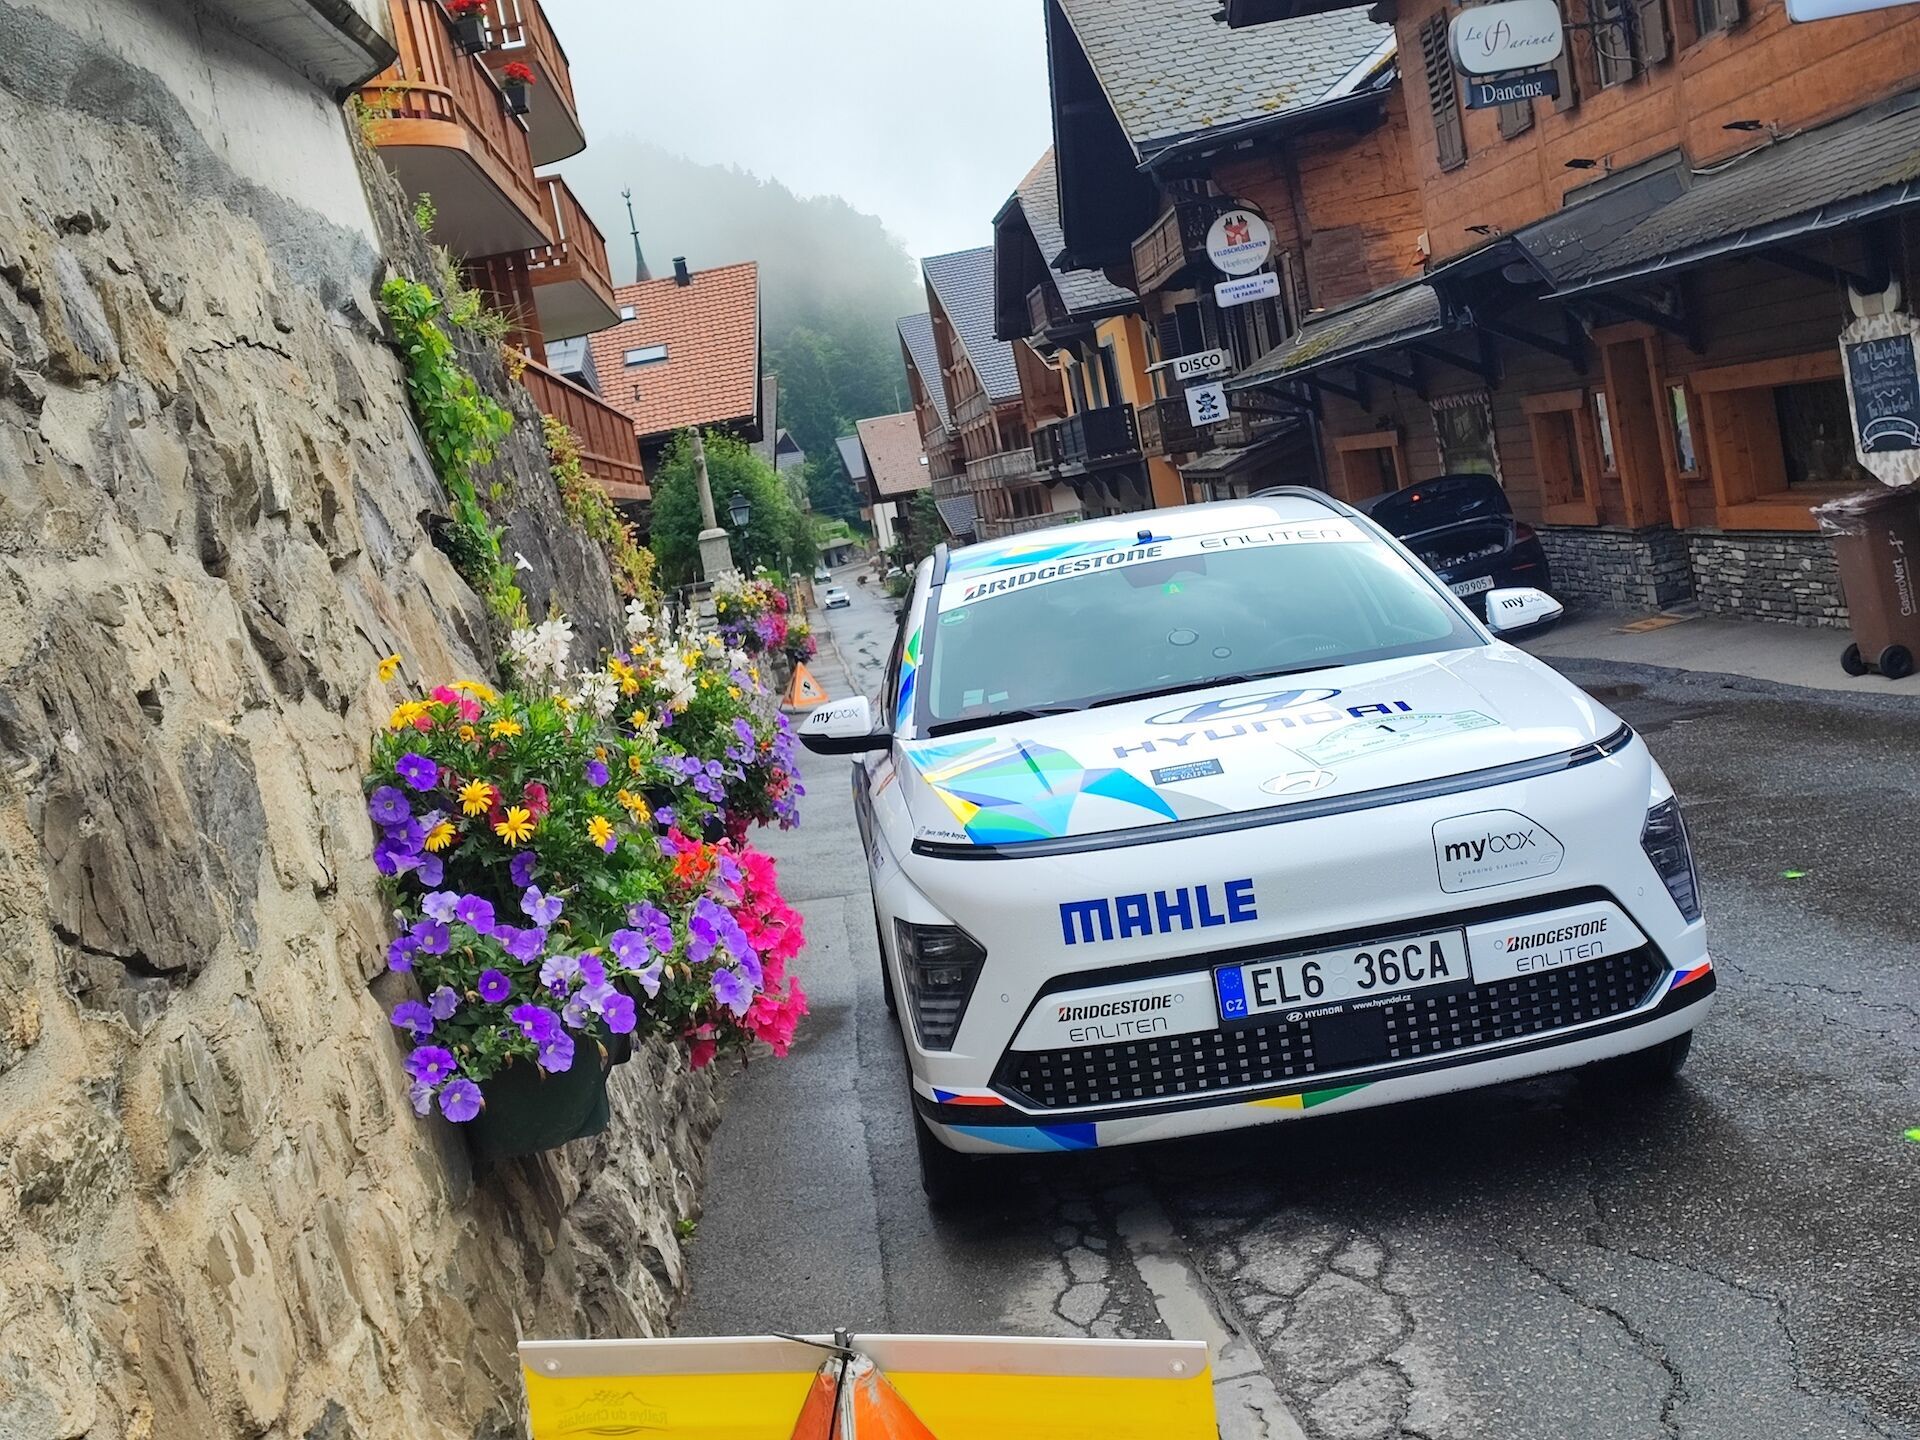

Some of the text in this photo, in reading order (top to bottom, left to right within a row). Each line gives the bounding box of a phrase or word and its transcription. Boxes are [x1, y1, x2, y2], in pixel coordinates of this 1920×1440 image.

[1465, 26, 1482, 41] Le
[1481, 79, 1543, 104] Dancing
[1221, 281, 1258, 294] RESTAURANT
[1242, 287, 1265, 297] FARINET
[1179, 354, 1221, 373] DISCO
[963, 528, 1342, 602] BRIDGESTONE ENLITEN
[1892, 558, 1912, 617] GastroVert
[1113, 701, 1413, 758] HYUNDAI
[1375, 724, 1397, 733] 1
[1444, 829, 1536, 862] mybox
[1059, 878, 1258, 946] MAHLE
[1506, 918, 1608, 953] BRIDGESTONE
[1516, 940, 1604, 972] ENLITEN
[1251, 940, 1450, 1008] EL6 36CA
[1058, 994, 1172, 1023] BRIDGESTONE
[1225, 998, 1245, 1013] CZ
[1304, 994, 1412, 1019] HYUNDAI www.hyundai.cz
[1069, 1016, 1168, 1042] ENLITEN
